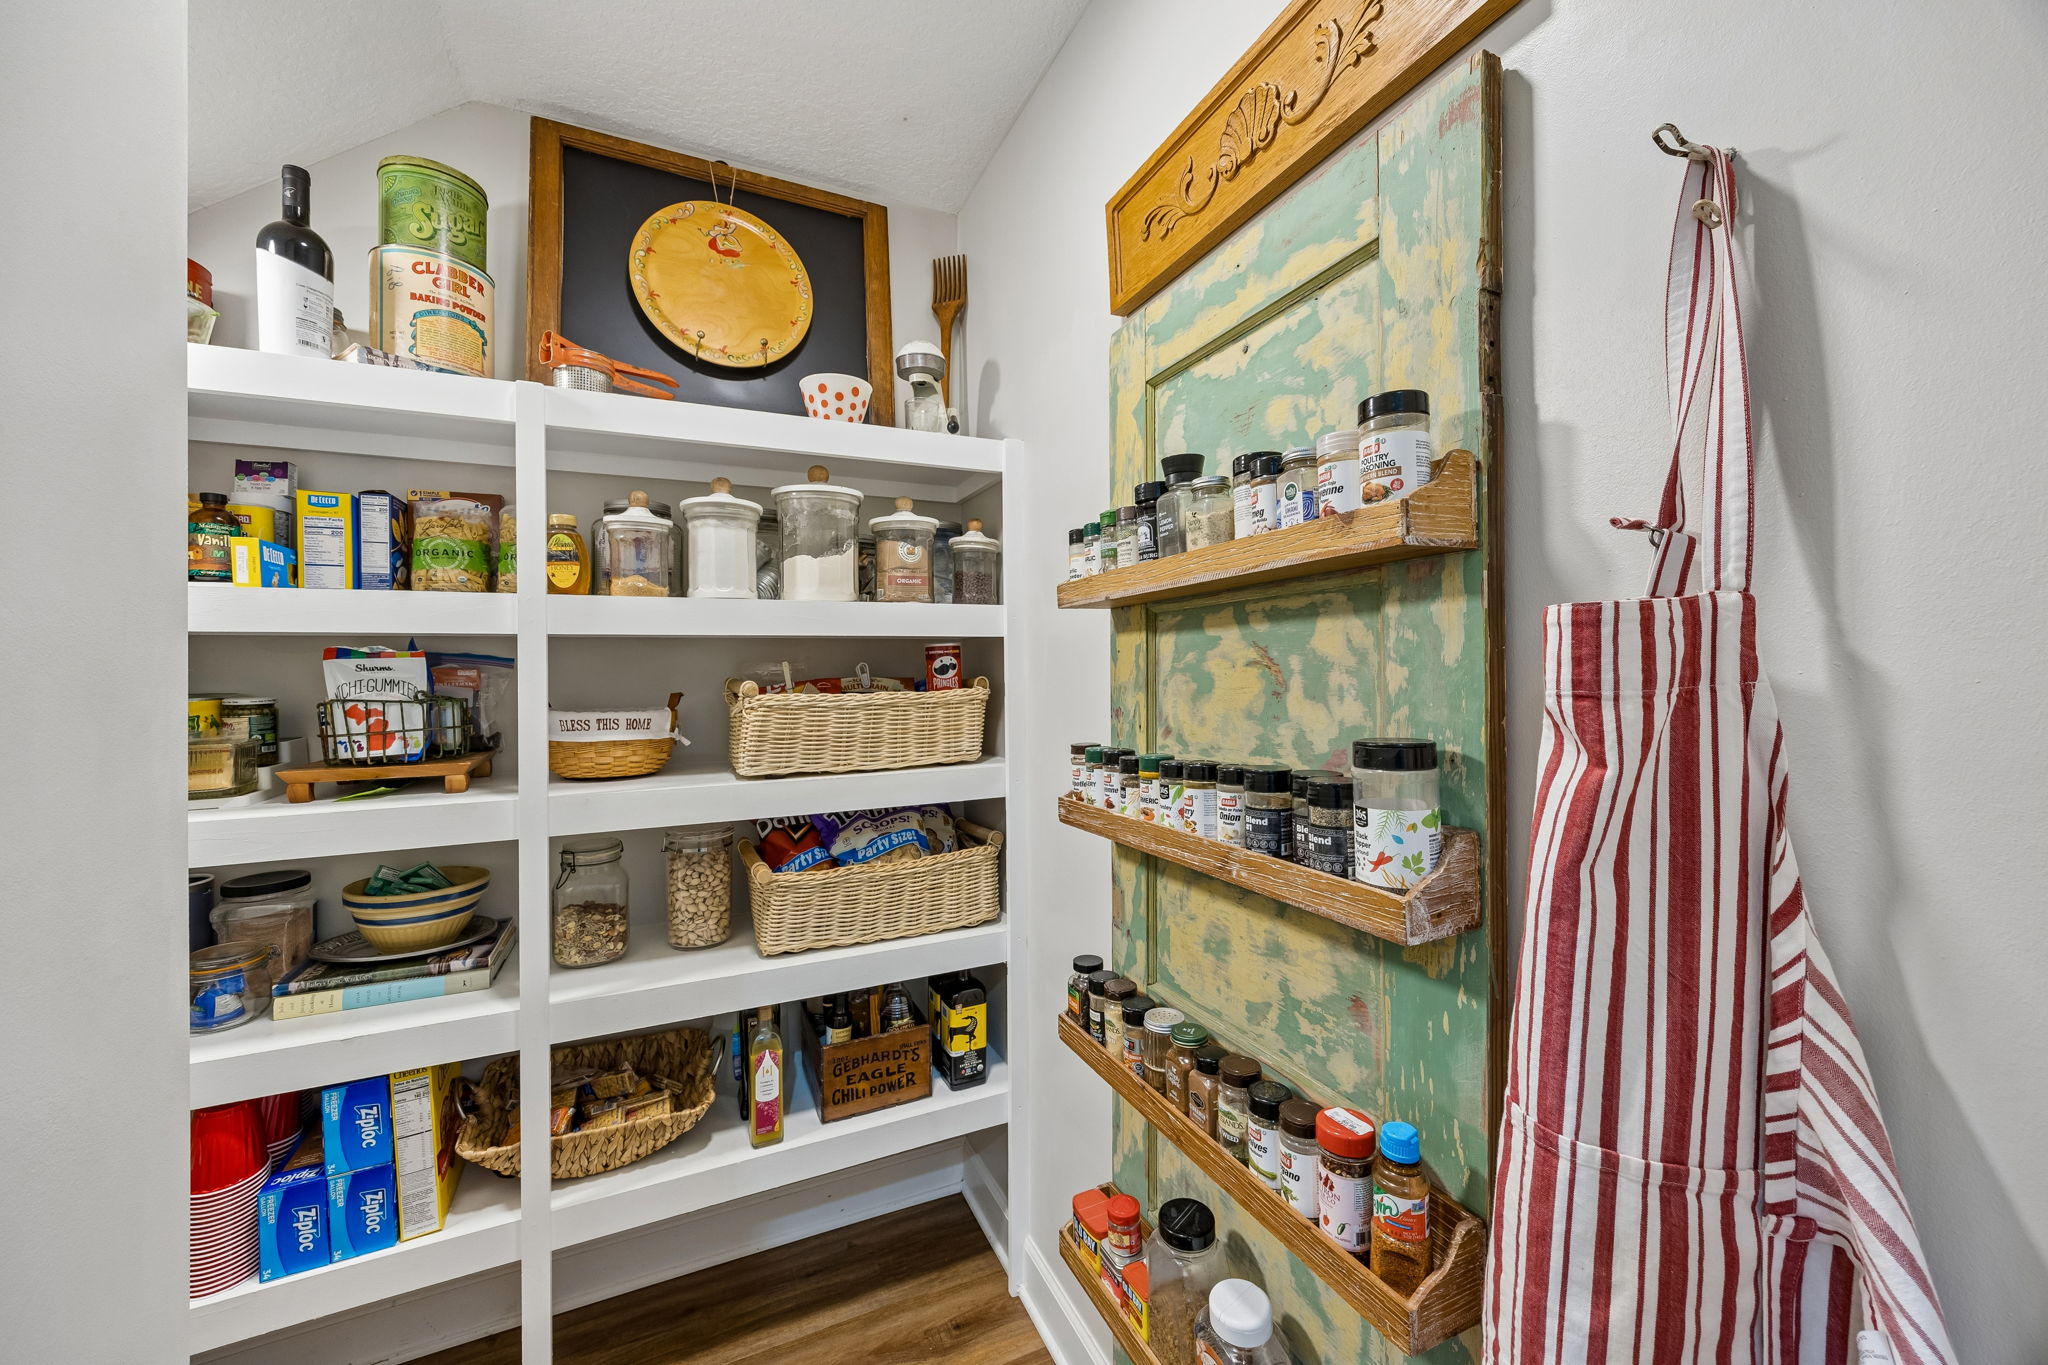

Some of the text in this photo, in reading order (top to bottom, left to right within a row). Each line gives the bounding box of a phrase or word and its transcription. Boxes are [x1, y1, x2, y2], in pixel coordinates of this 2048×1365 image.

[409, 201, 485, 246] Sugar
[411, 261, 485, 297] CLABBER
[432, 276, 471, 299] GIRL
[410, 291, 451, 308] BAKING
[452, 302, 486, 323] POWDER
[1361, 452, 1389, 466] POULTRY
[1360, 460, 1396, 474] EASONING
[1320, 485, 1344, 498] enne
[1252, 509, 1265, 519] meg
[415, 548, 474, 558] ORGANIC
[354, 663, 394, 673] Shurms
[841, 683, 889, 692] MULTIRAIN
[932, 677, 959, 689] PRINGLES
[559, 718, 652, 732] BLESS THIS HOME
[1140, 796, 1159, 804] MERIC
[1219, 811, 1241, 822] Onion
[1245, 814, 1269, 826] Blend
[852, 815, 910, 835] SCOOPS!
[1296, 824, 1309, 834] Ble
[856, 830, 917, 860] Party Size!
[1308, 832, 1332, 845] Blend
[813, 847, 829, 860] Siz
[832, 1046, 920, 1078] GEBHARDT'S
[846, 1062, 907, 1086] EAGLE
[831, 1071, 917, 1106] CHILI POWER
[330, 1092, 339, 1121] FREEZER
[355, 1105, 379, 1149] Ziploc
[1249, 1139, 1269, 1154] ives
[326, 1163, 336, 1175] 34
[1280, 1165, 1301, 1182] gano
[270, 1167, 322, 1186] Ziploc
[335, 1178, 345, 1208] FREEZER
[267, 1194, 276, 1225] FREEZER
[360, 1191, 383, 1235] Ziploc
[292, 1207, 317, 1253] Ziploc
[333, 1249, 342, 1261] 34
[262, 1268, 272, 1280] 34
